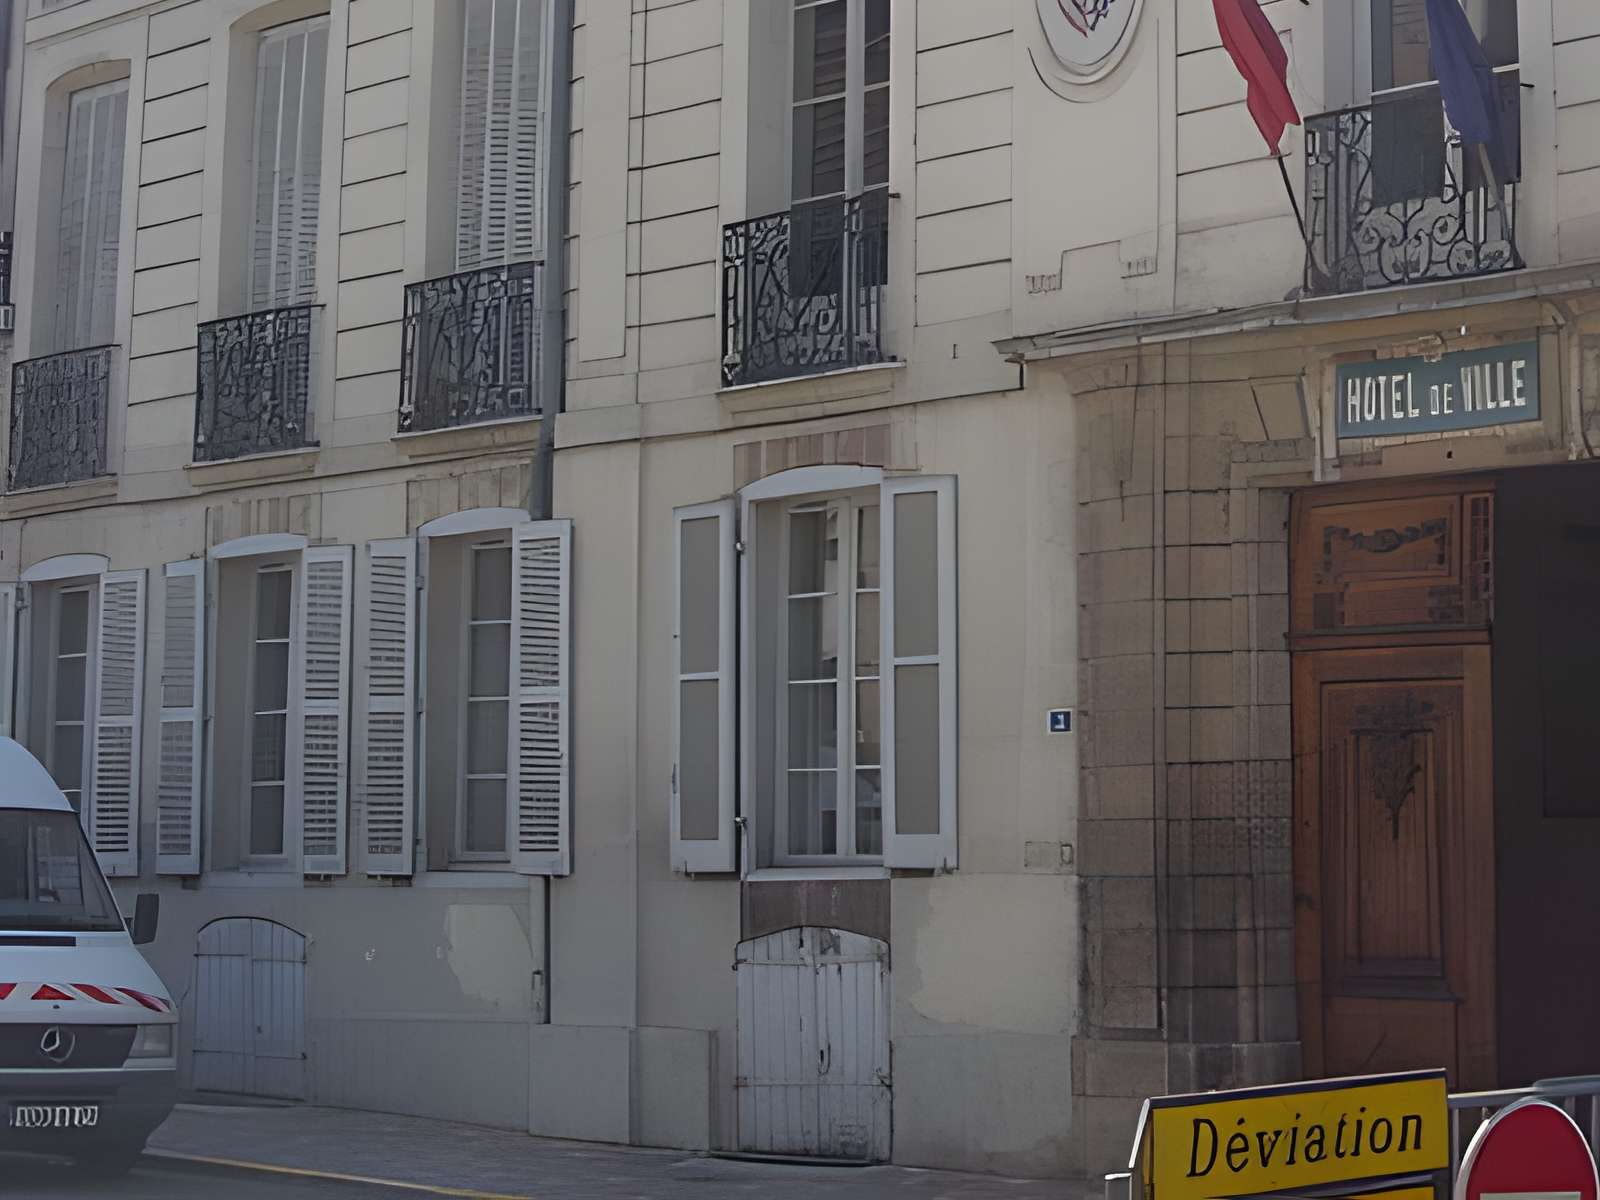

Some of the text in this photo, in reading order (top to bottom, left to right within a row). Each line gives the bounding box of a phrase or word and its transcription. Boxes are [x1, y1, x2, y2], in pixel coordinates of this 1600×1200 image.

[1347, 359, 1526, 423] HOTEL DE VILLE
[1186, 1106, 1423, 1179] Déviation
